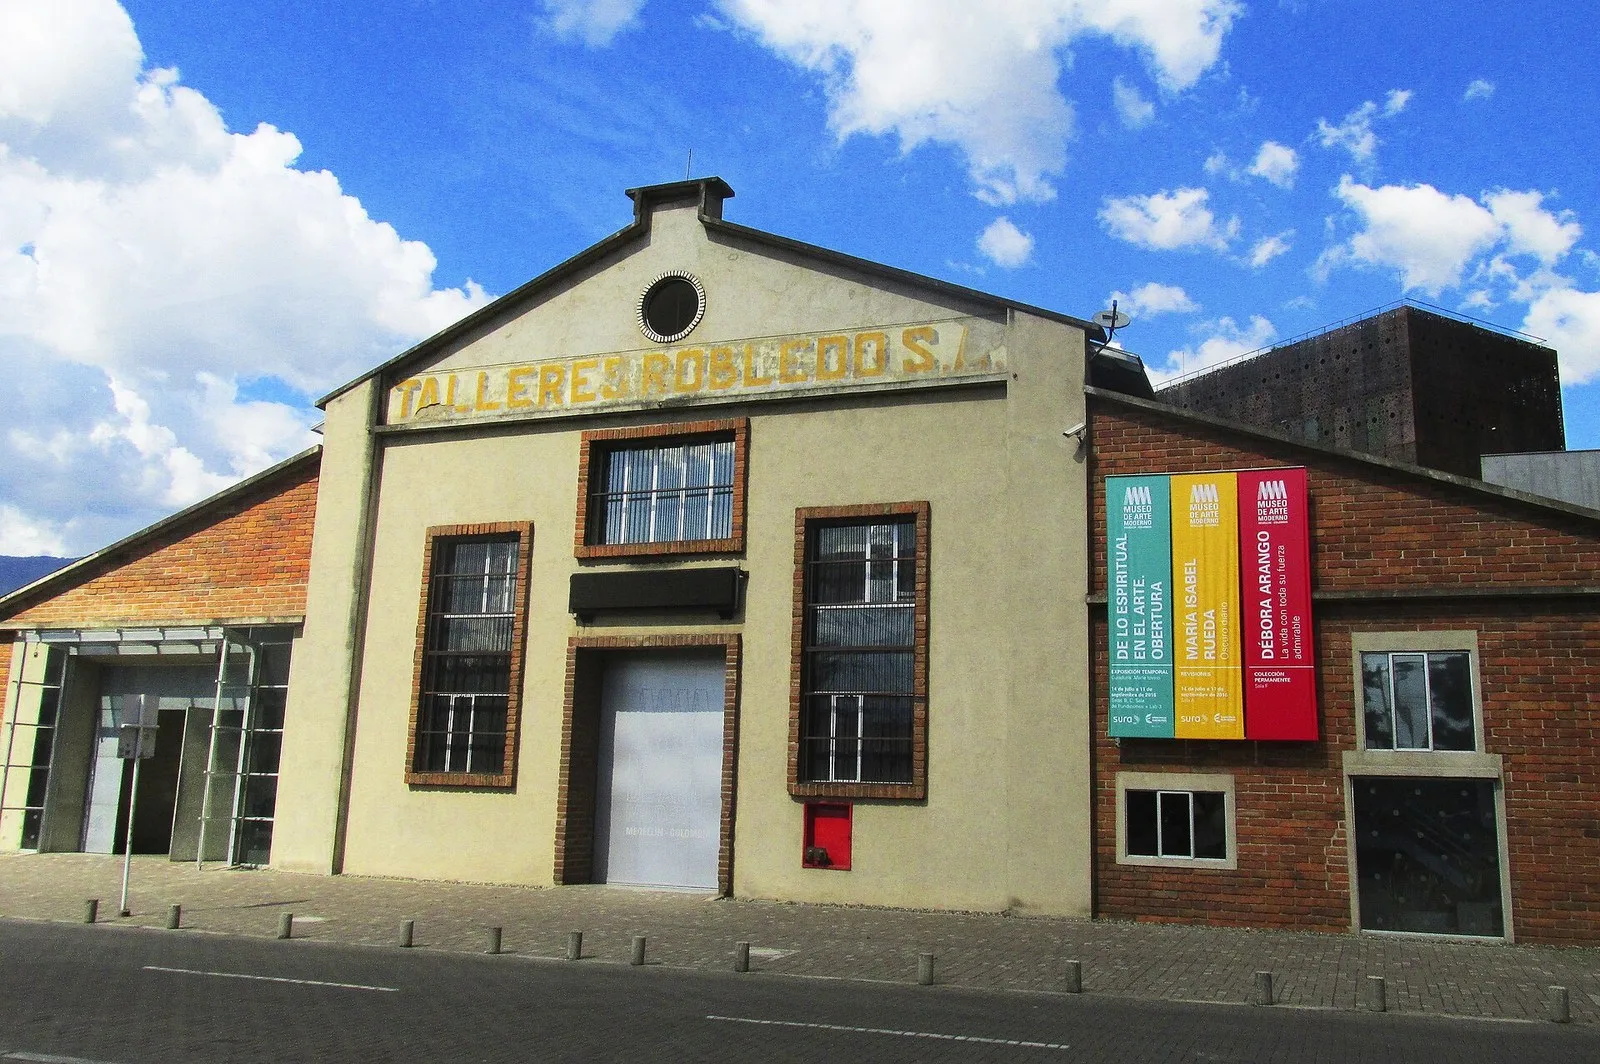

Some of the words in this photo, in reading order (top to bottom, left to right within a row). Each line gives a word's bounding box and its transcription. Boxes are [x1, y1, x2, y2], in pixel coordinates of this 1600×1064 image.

[398, 357, 629, 418] TALLERES
[641, 331, 890, 399] ROBLEDO
[1190, 503, 1219, 511] MUSEO
[1257, 500, 1288, 508] MUSEO
[1257, 530, 1272, 594] ARANGO
[1277, 545, 1285, 572] fuerza
[1116, 533, 1128, 614] ESPIRITUAL
[1185, 558, 1198, 608] ISABEL
[1279, 574, 1286, 585] su
[1133, 575, 1145, 615] ARTE.
[1278, 588, 1287, 607] toda
[1151, 581, 1163, 660] OBERTURA
[1220, 601, 1229, 625] diario
[1280, 610, 1288, 626] con
[1116, 618, 1128, 637] LO
[1134, 619, 1145, 636] EL
[1183, 612, 1198, 660] MARÍA
[1204, 609, 1216, 660] RUEDA
[1258, 598, 1274, 660] DÉBORA
[1280, 628, 1288, 646] vida
[1292, 616, 1301, 660] admirable
[1117, 641, 1129, 660] DE
[1134, 640, 1146, 660] EN
[1220, 627, 1229, 660] Oscuro
[1281, 648, 1289, 660] La
[1181, 715, 1201, 723] sura
